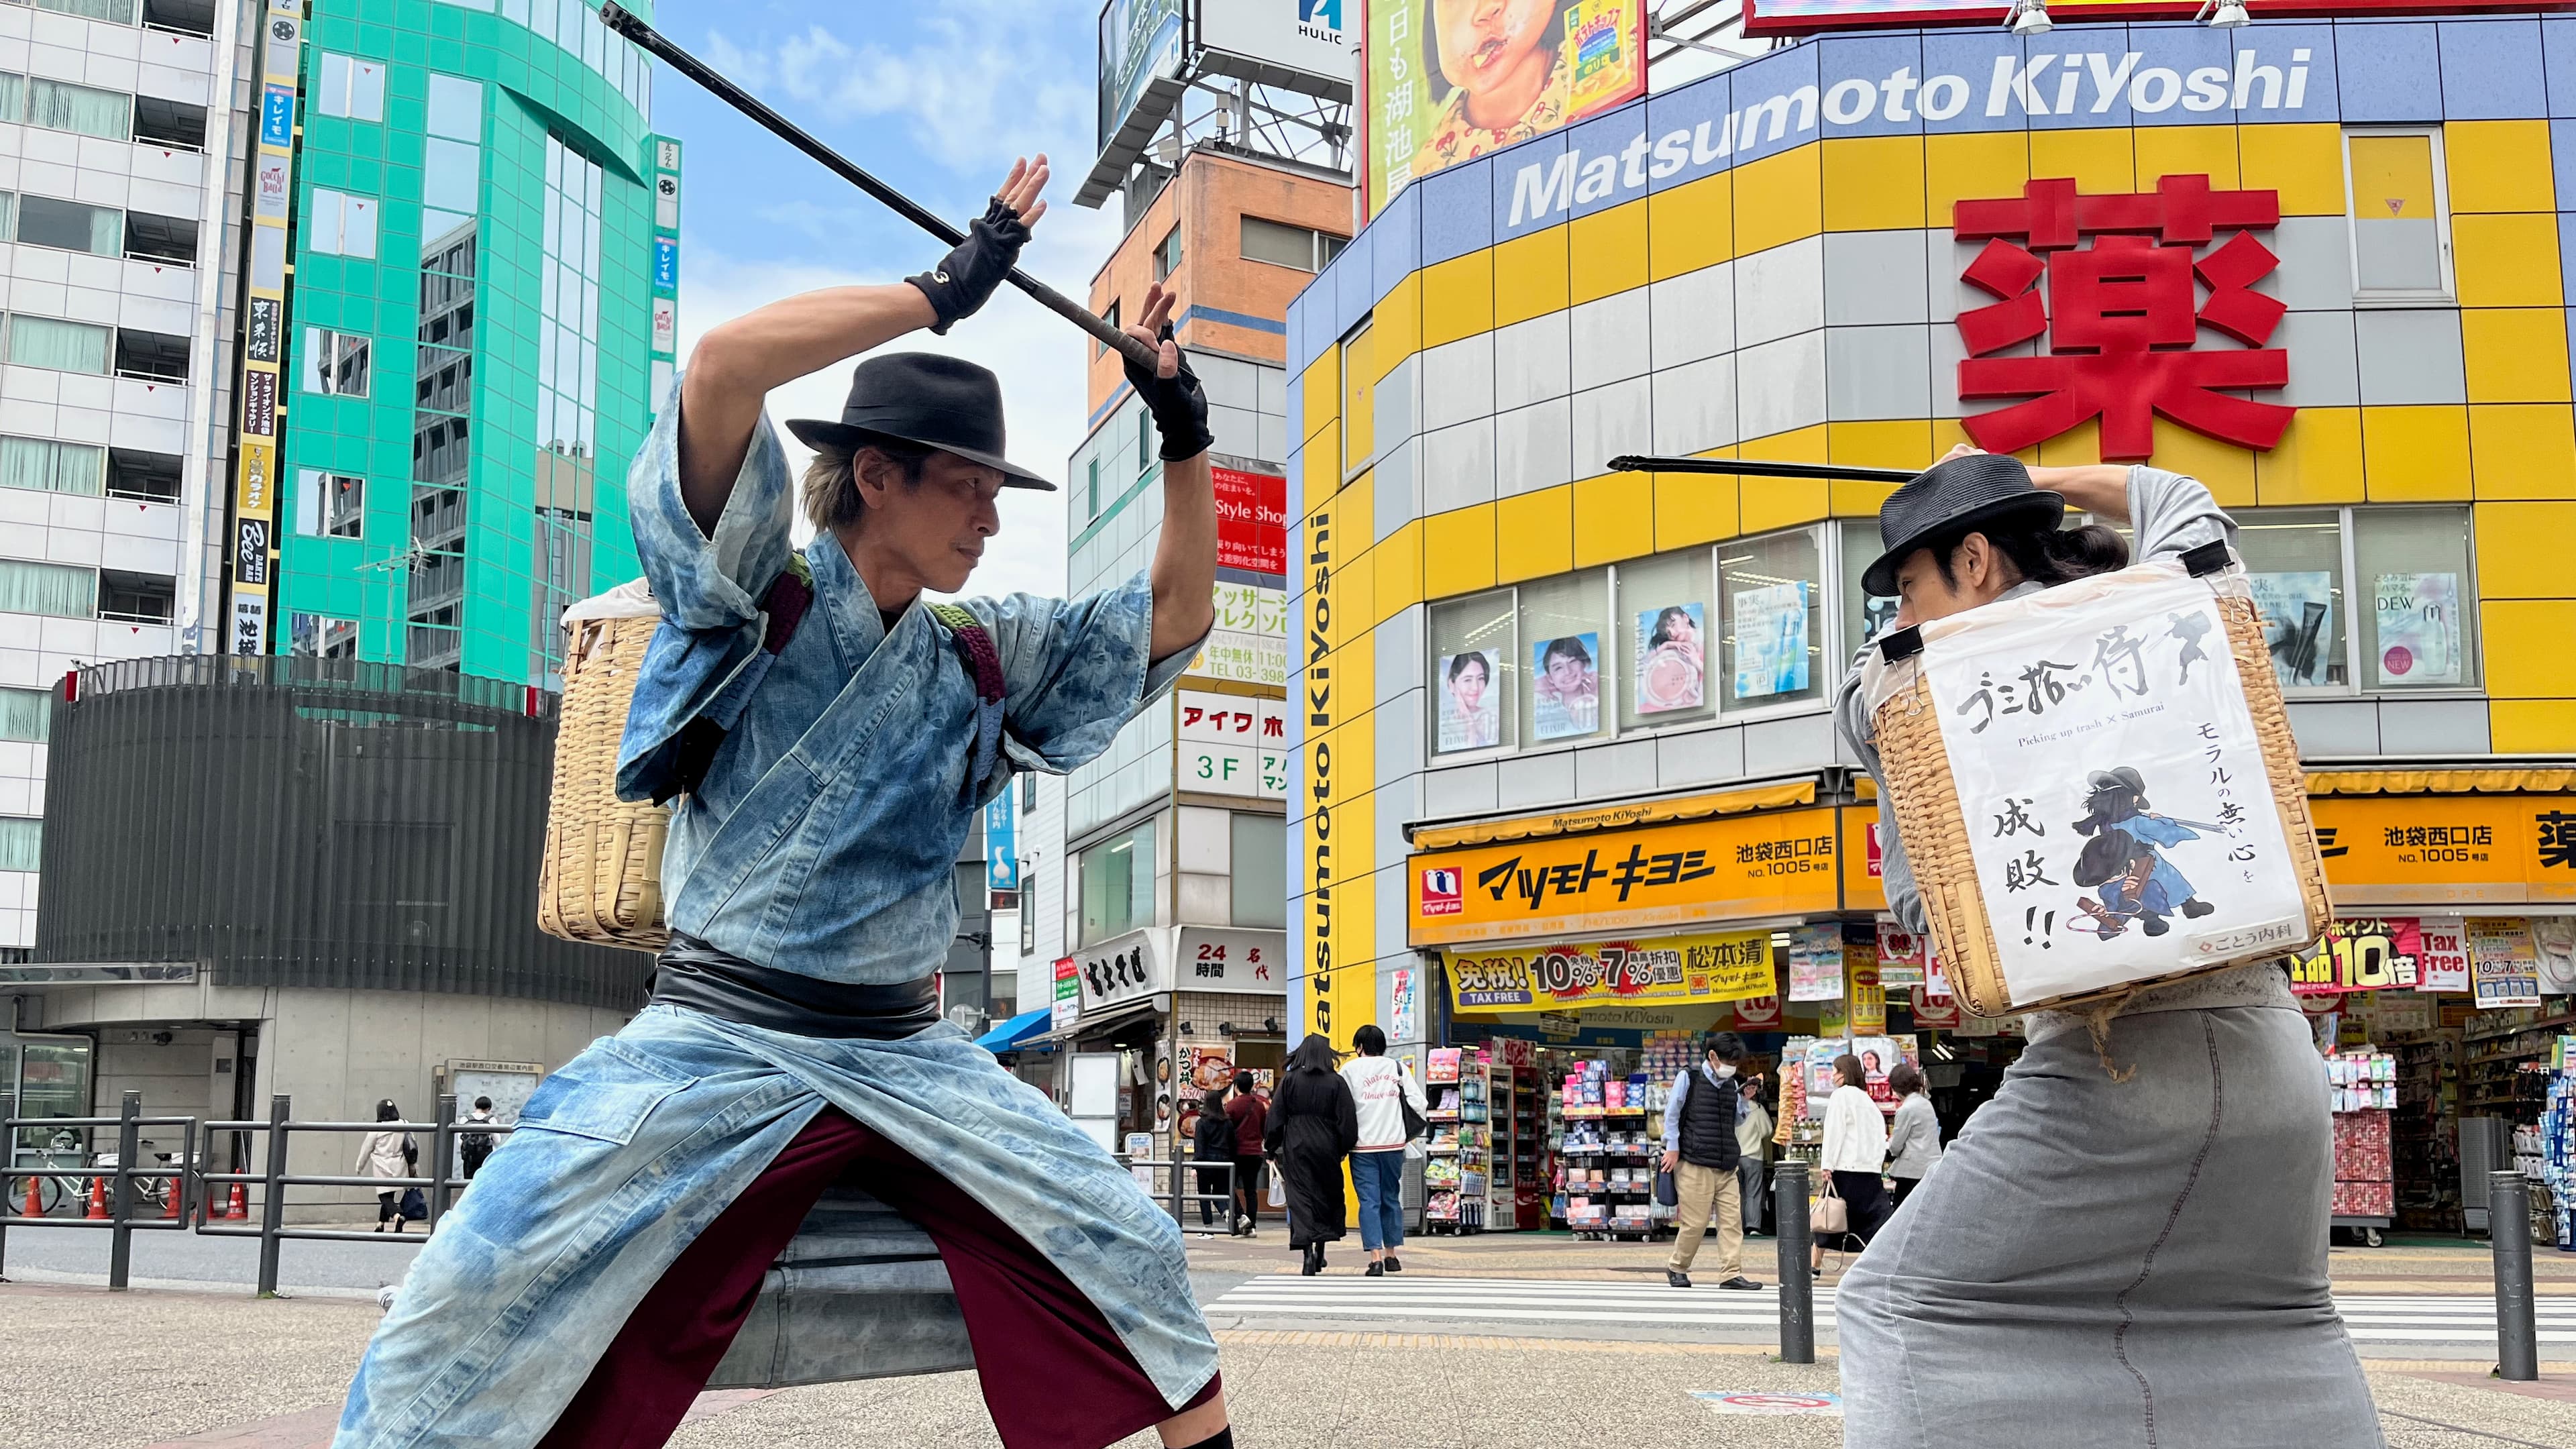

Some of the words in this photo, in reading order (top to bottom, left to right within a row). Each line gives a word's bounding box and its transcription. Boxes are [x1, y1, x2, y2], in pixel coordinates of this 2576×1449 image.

[1299, 24, 1342, 45] HULIC
[271, 95, 284, 136] キレイモ
[1507, 73, 1970, 227] Matsumoto
[1986, 48, 2312, 118] KiYoshi
[1953, 174, 2297, 462] 薬
[1216, 500, 1252, 521] Style
[2377, 596, 2414, 611] DEW
[1310, 514, 1330, 727] KiYoshi
[1210, 645, 1253, 665] 年中無休
[2387, 660, 2410, 670] NEW
[1210, 662, 1232, 676] TEL
[2018, 731, 2057, 748] Picking
[2059, 729, 2074, 741] up
[2077, 720, 2102, 734] trash
[2121, 700, 2165, 722] Samurai
[2195, 722, 2257, 883] モラルの無い心を
[1553, 812, 1611, 828] Matsumoto
[1613, 806, 1652, 820] KiYoshi
[2383, 825, 2493, 847] 池袋西口店
[1736, 836, 1833, 864] 池袋西口店
[1479, 844, 1716, 910] マツモトキヨシ
[1309, 741, 1332, 1037] atsumoto
[2331, 918, 2389, 936] ポイント
[2214, 924, 2293, 953] ごとう内科
[2420, 932, 2459, 951] Tax
[1197, 943, 1226, 960] 24
[1686, 938, 1762, 969] 松本清
[2422, 953, 2465, 972] Free
[1196, 962, 1224, 978] 時間
[1710, 971, 1766, 985] マツモトキヨシ
[1469, 992, 1493, 1004] TAX
[1494, 991, 1521, 1003] FREE
[1178, 1046, 1193, 1085] かつ丼
